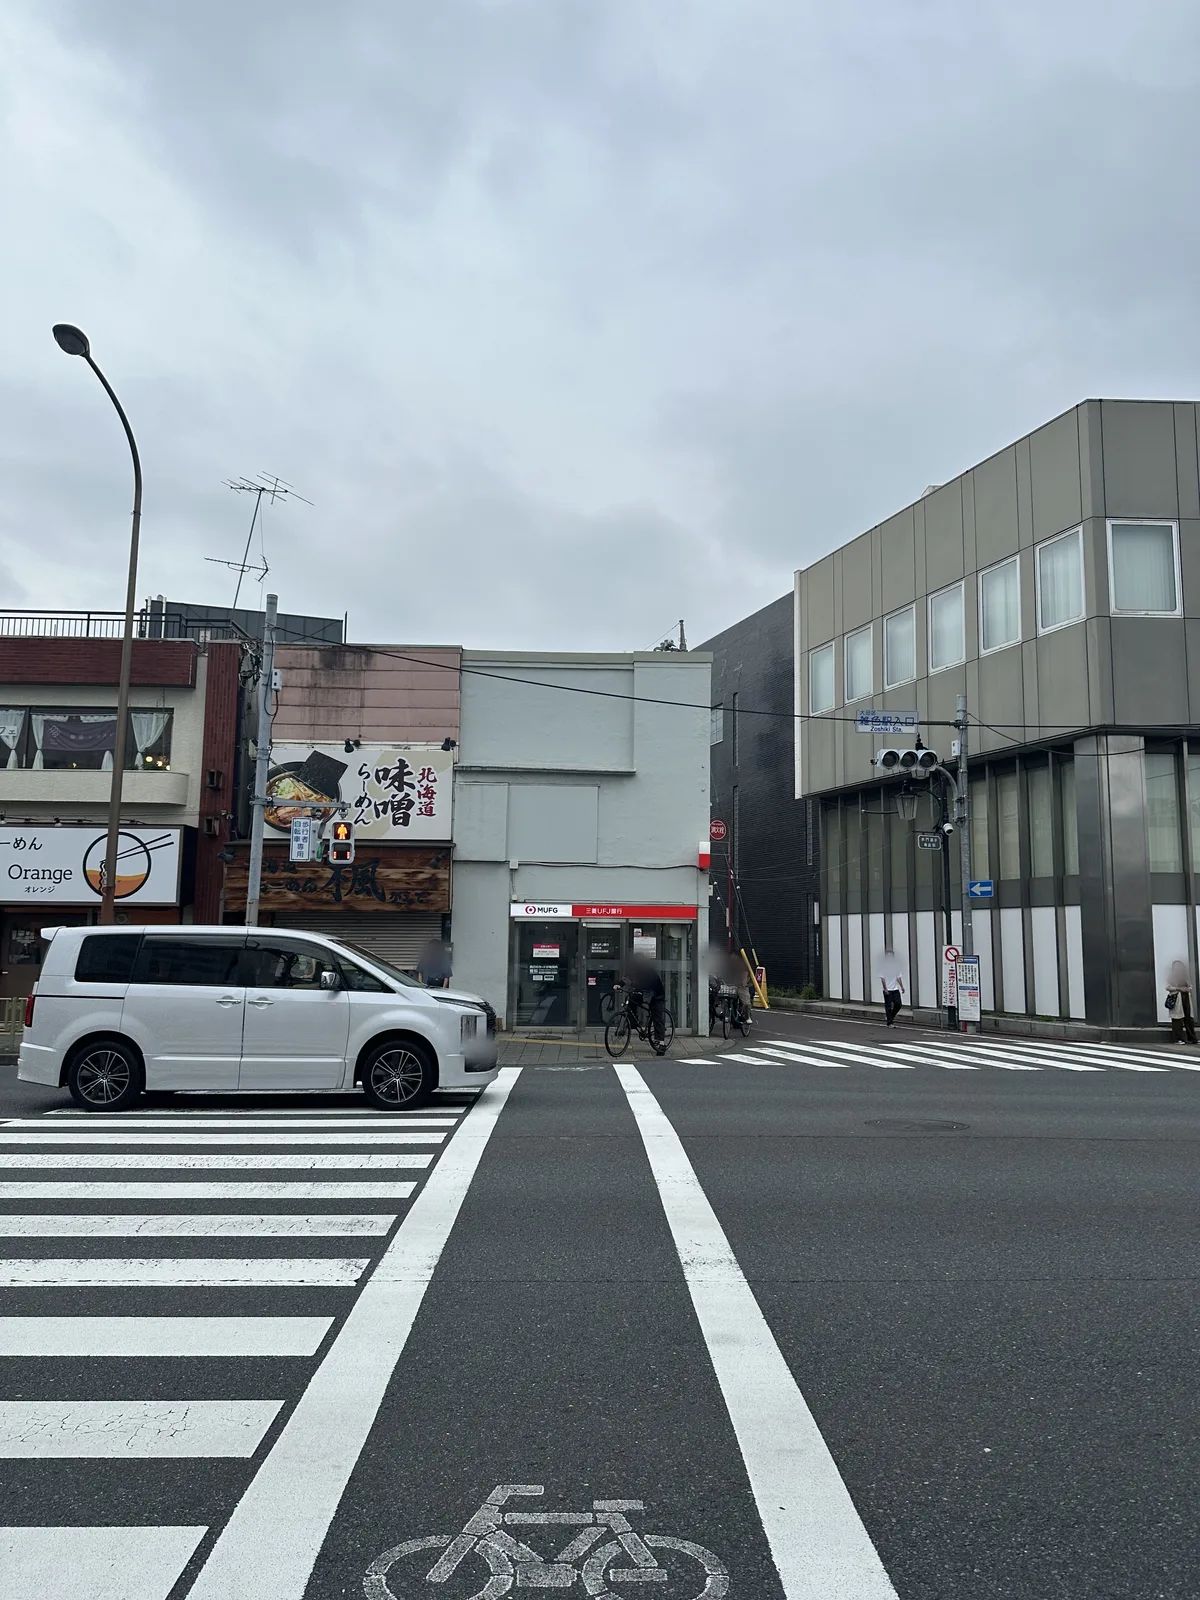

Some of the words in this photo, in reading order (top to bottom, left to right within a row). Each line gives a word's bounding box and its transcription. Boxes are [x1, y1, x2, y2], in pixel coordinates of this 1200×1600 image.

[860, 716, 914, 727] 雑色駅入口
[354, 763, 372, 825] らーめん
[374, 758, 416, 827] 味噌
[416, 767, 438, 817] 北海道
[8, 864, 73, 884] Orange
[24, 885, 56, 894] オレンジ
[586, 907, 623, 915] 三菱UFJ銀行
